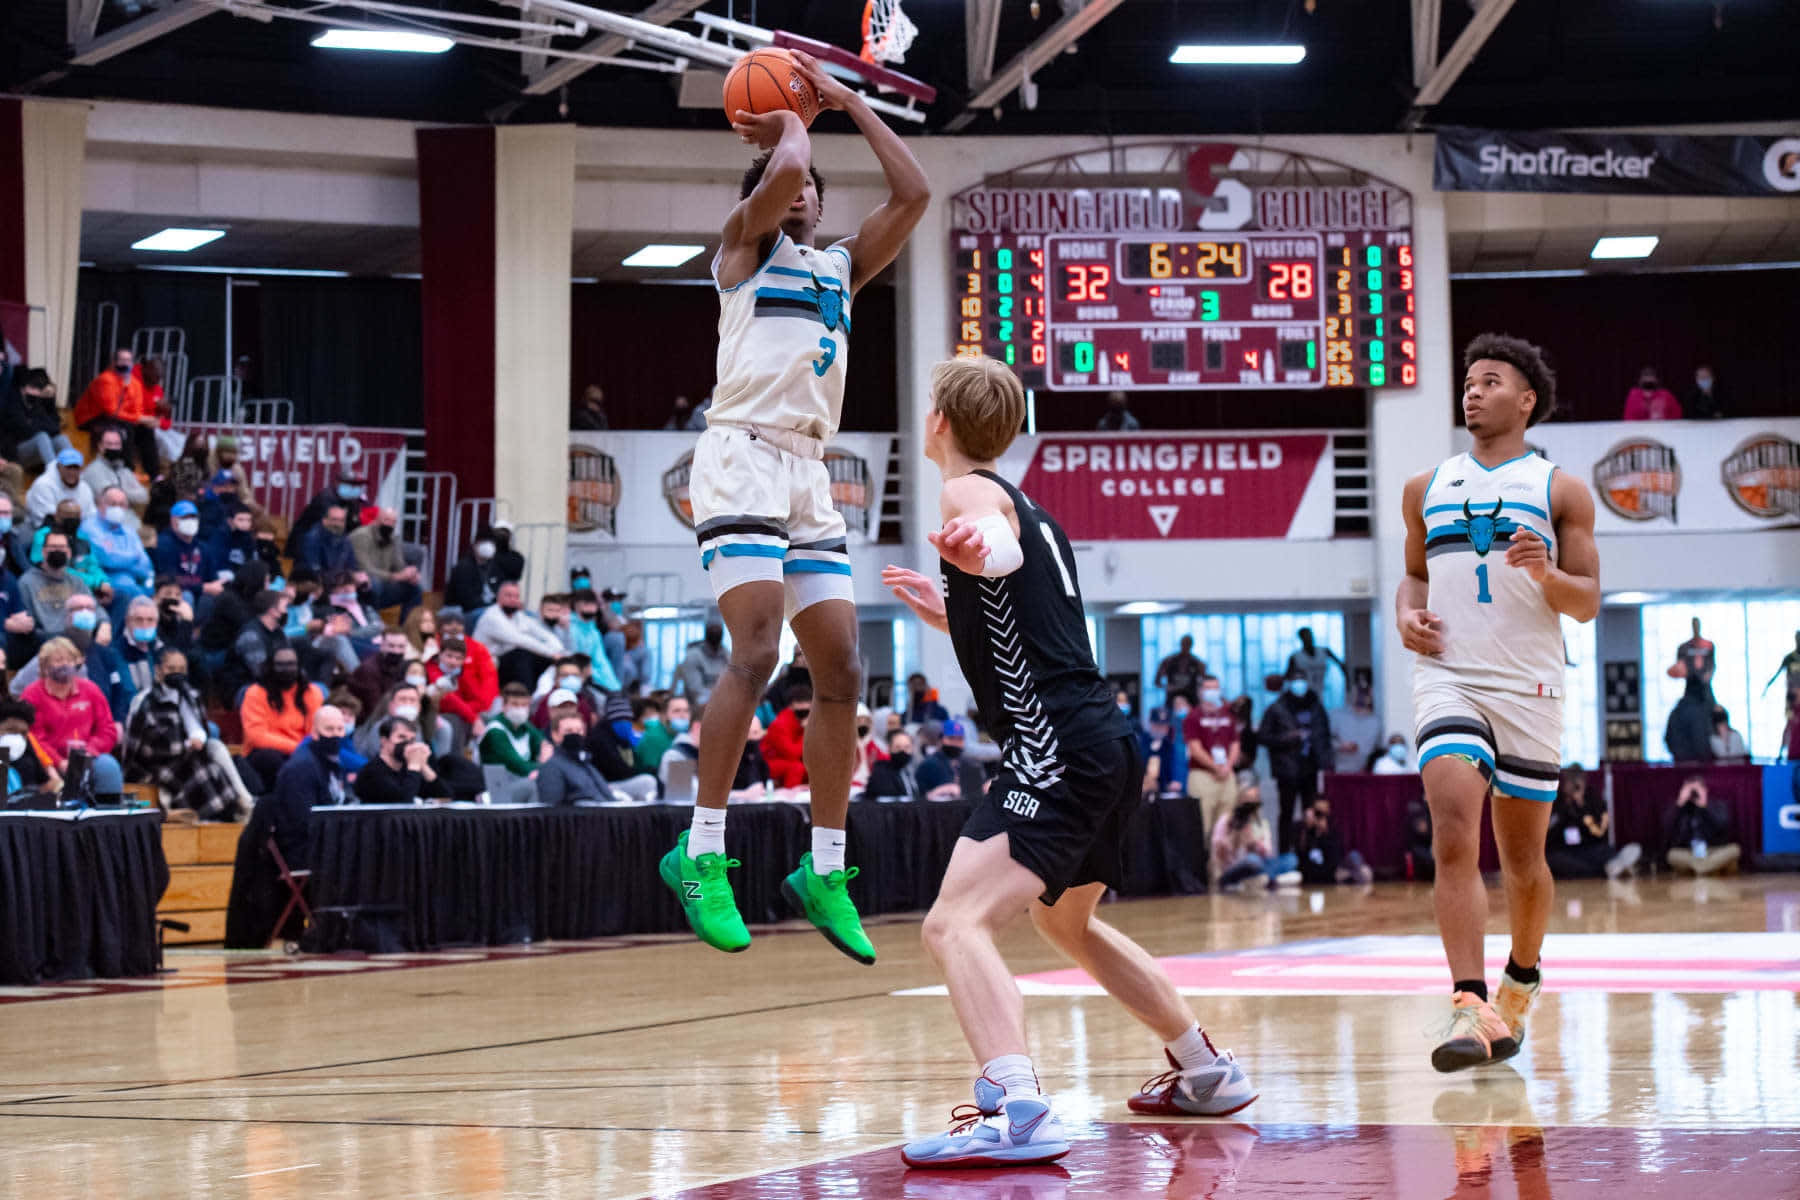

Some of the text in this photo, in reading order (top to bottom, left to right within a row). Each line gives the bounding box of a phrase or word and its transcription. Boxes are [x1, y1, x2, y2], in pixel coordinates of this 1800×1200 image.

[1480, 145, 1653, 178] ShotTracker
[967, 189, 1184, 234] SPRINGFIELD
[1058, 242, 1106, 259] HOME
[1149, 242, 1242, 279] 6:24
[1254, 240, 1316, 257] VISITOR
[1065, 264, 1110, 301] 32
[1268, 263, 1313, 299] 28
[961, 296, 982, 318] 10
[1024, 296, 1045, 317] 11
[1200, 290, 1219, 321] 3
[961, 319, 983, 341] 15
[1326, 316, 1353, 338] 21
[812, 336, 837, 377] 3
[1074, 341, 1095, 372] 0
[1114, 351, 1130, 372] 4
[1243, 350, 1258, 370] 4
[1306, 340, 1316, 369] 1
[1326, 340, 1353, 362] 25
[1327, 364, 1354, 386] 35
[1042, 443, 1283, 472] SPRINGFIELD
[1101, 478, 1225, 496] COLLEGE
[1040, 521, 1077, 597] 1
[1475, 563, 1492, 604] 1
[1003, 790, 1040, 819] SCA
